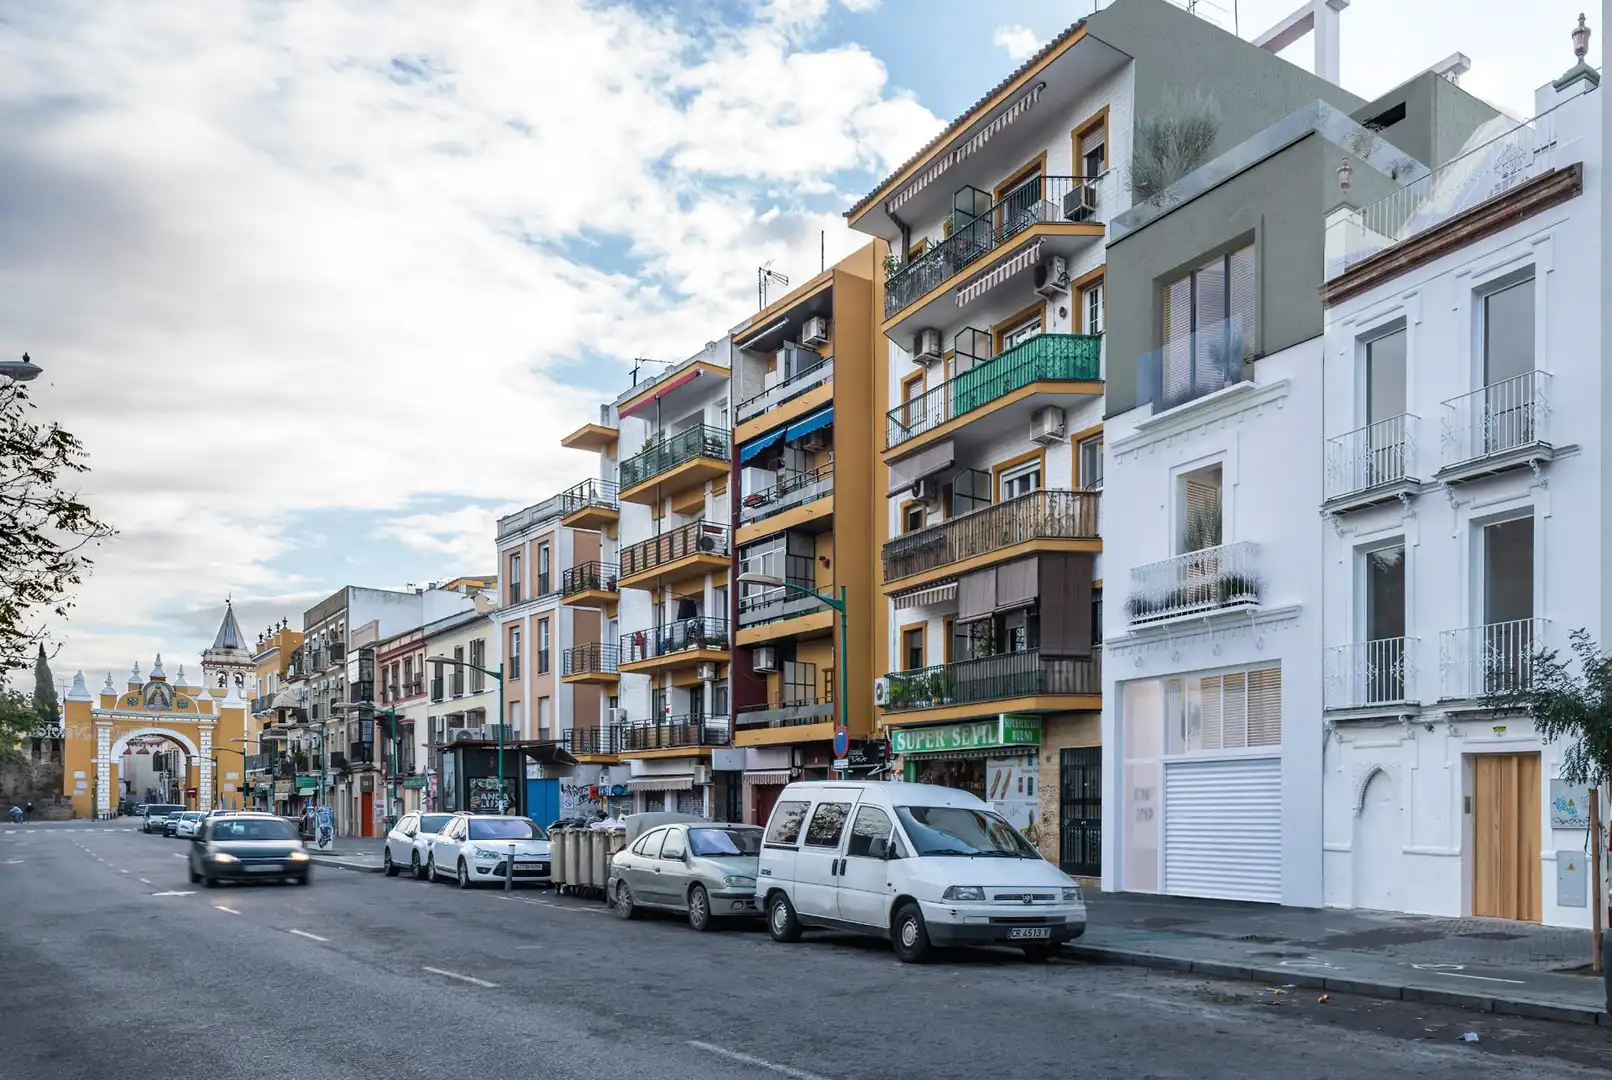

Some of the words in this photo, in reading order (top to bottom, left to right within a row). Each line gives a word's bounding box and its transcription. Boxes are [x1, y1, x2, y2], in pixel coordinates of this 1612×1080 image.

[896, 729, 946, 751] SUPER
[951, 723, 1000, 746] SEVIL
[1023, 928, 1042, 937] 4513
